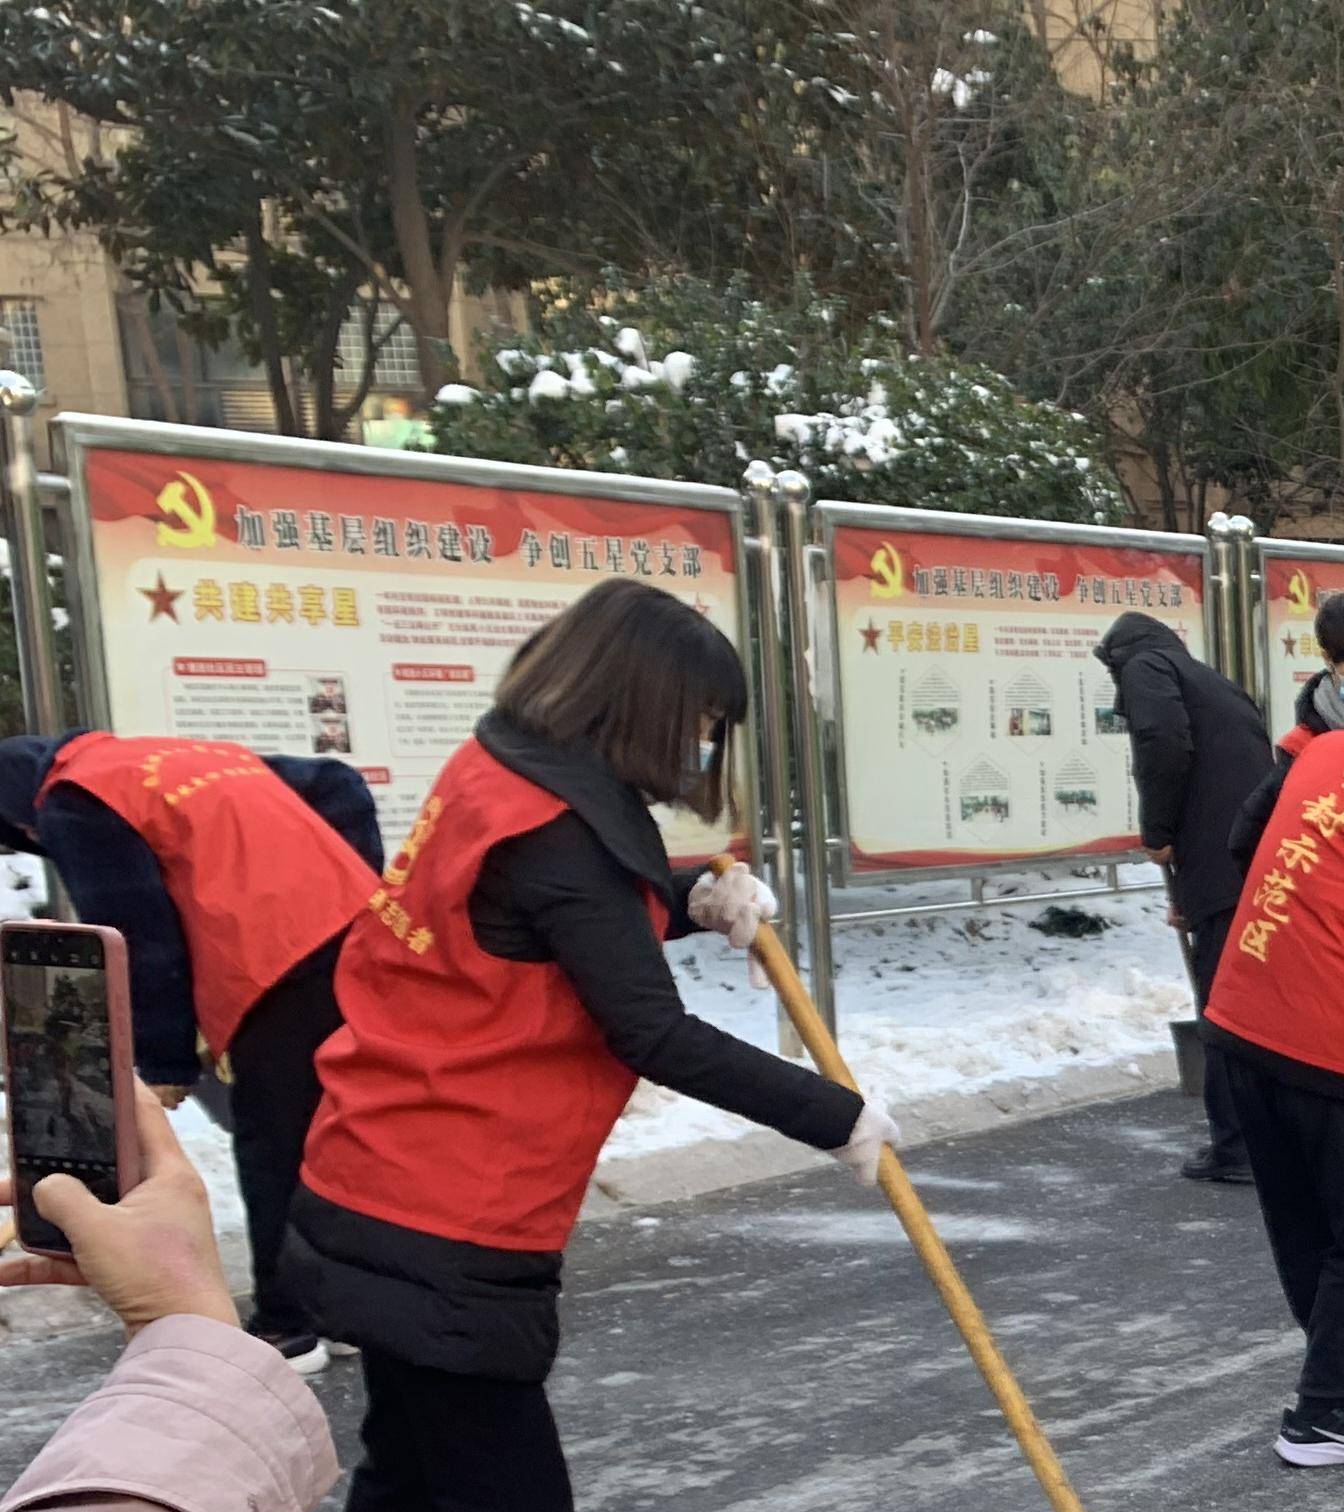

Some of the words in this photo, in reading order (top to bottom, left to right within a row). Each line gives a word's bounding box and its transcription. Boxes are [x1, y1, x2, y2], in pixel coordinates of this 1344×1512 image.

[236, 505, 494, 564] 加强基层组织建设
[519, 527, 704, 580] 争创五星党支部
[192, 578, 361, 628] 共建共享星
[913, 565, 1061, 602] 加强基层组织建设
[1076, 576, 1184, 607] 争创五星党支部
